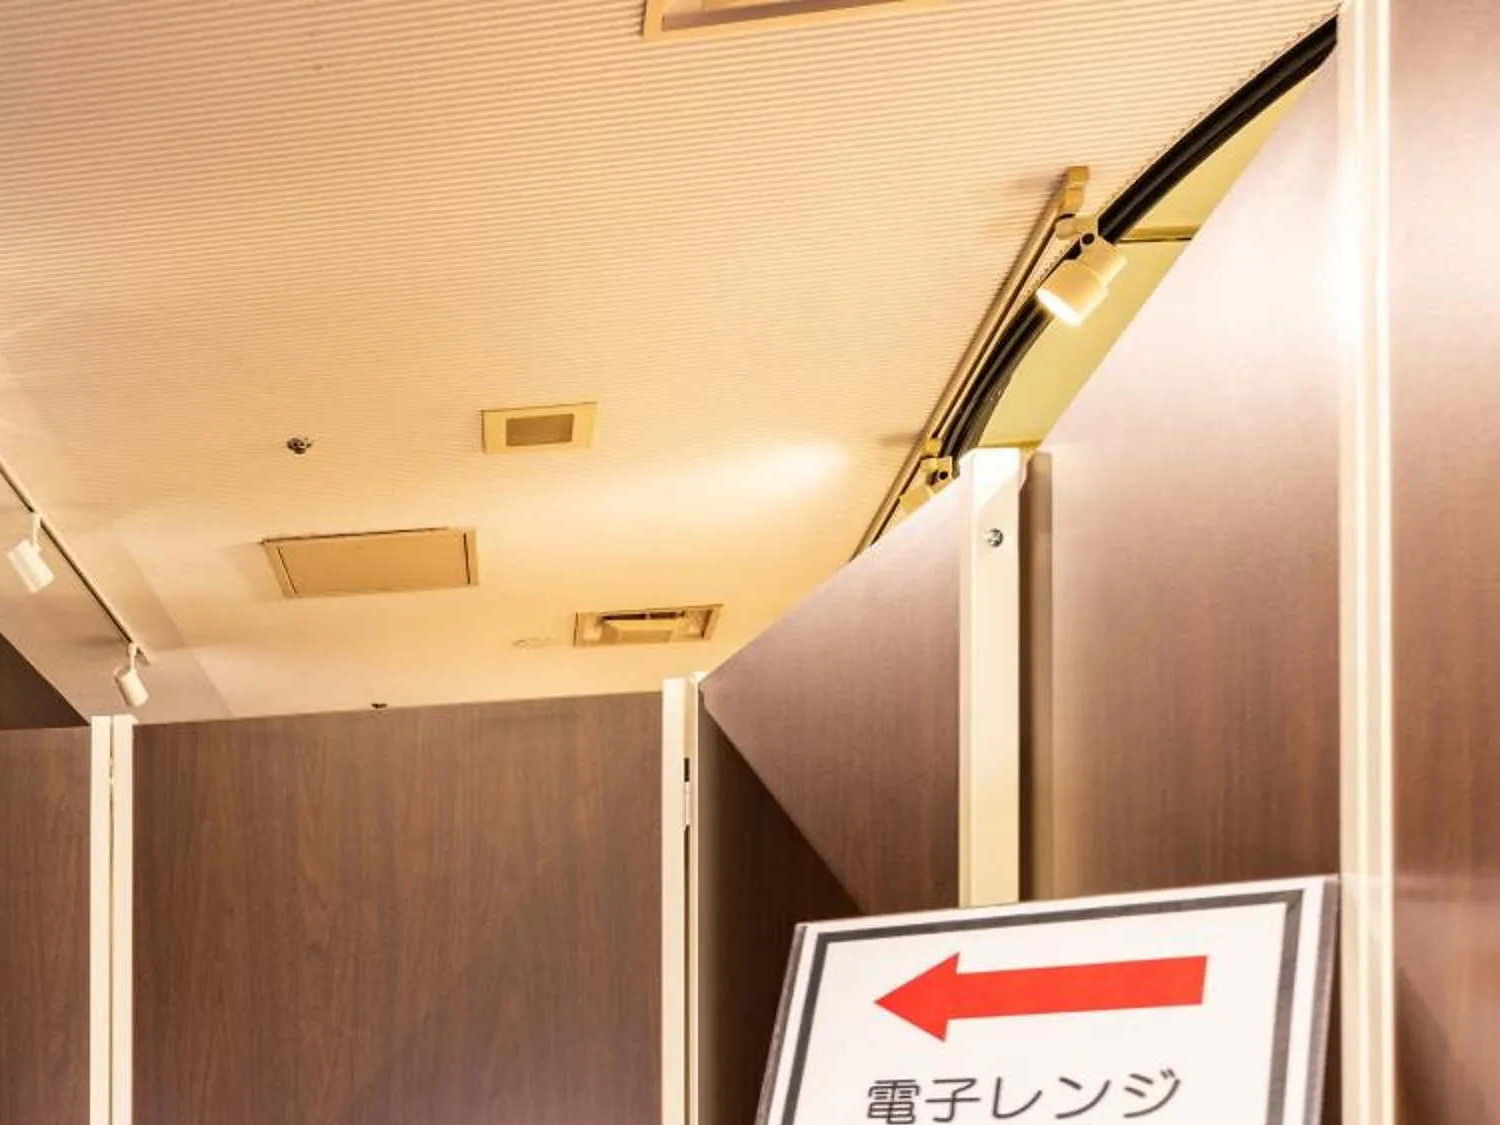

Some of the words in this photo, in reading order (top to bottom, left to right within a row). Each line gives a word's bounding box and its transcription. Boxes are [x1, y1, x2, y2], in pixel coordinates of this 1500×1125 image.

[866, 1068, 1182, 1125] 電子レンジ
